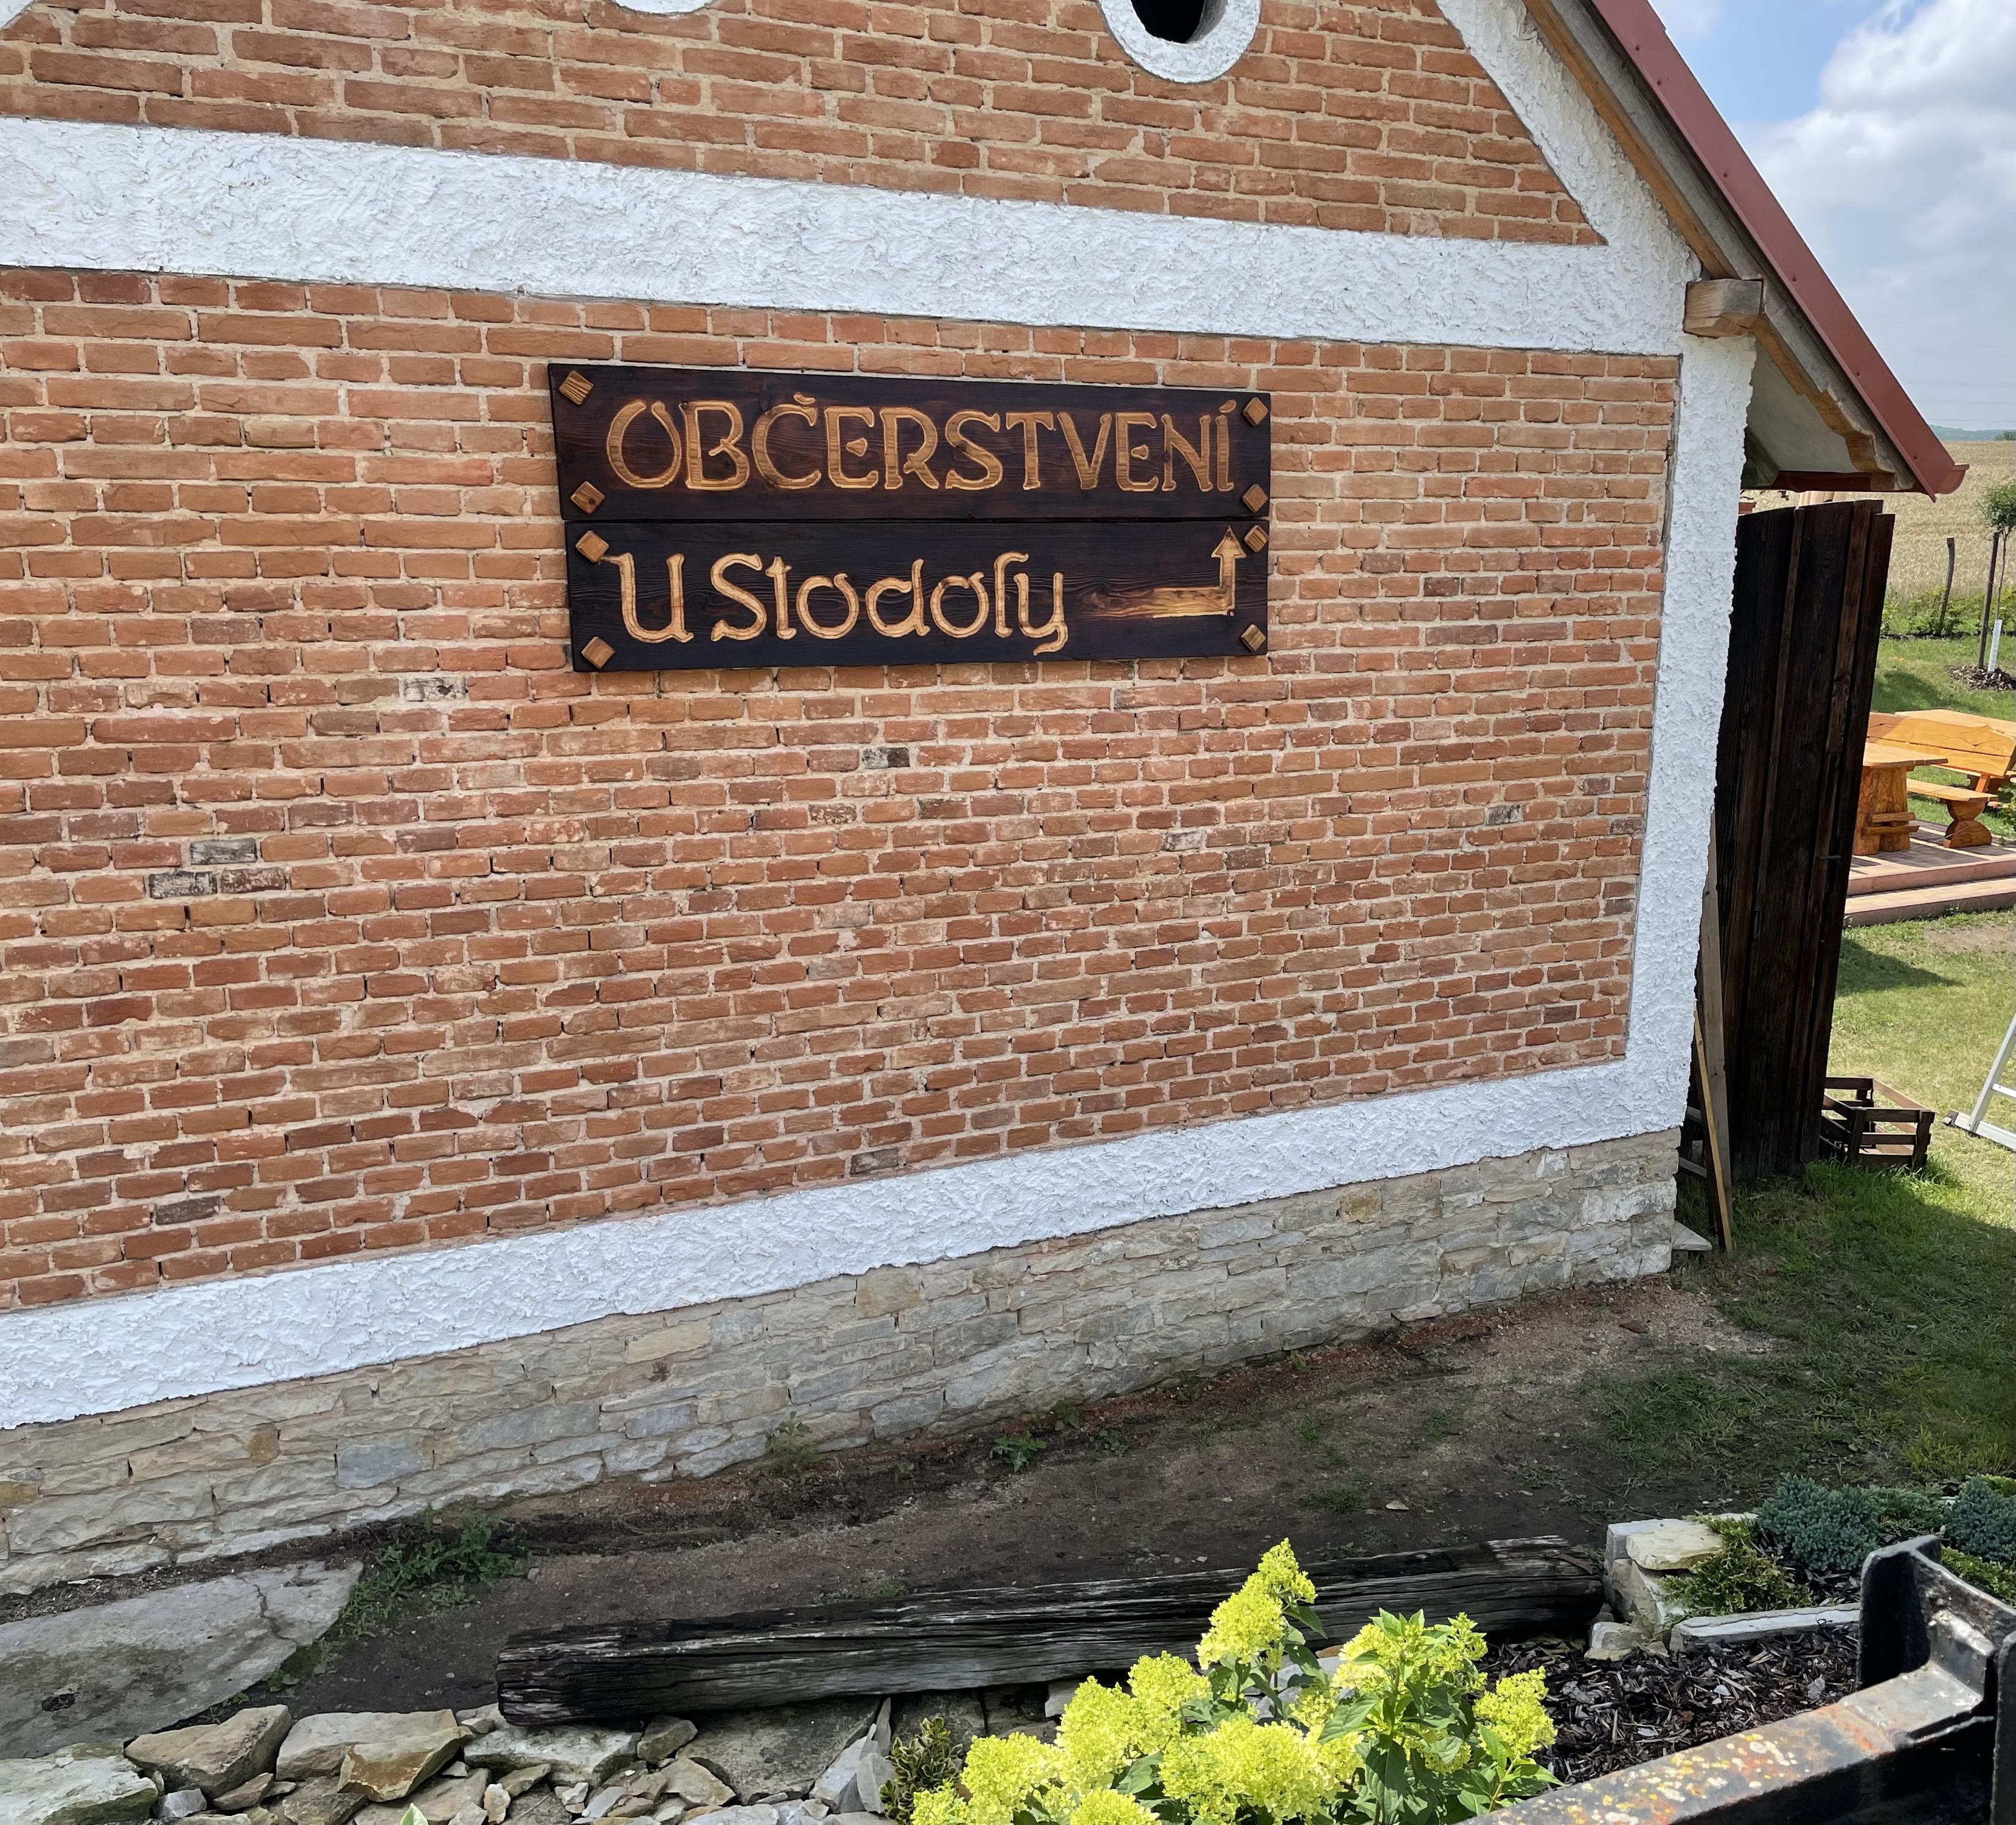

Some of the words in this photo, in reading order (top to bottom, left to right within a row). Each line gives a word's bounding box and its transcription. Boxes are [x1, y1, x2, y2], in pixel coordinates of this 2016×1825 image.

[606, 392, 1237, 493] OBČERSTVENÍ
[601, 552, 694, 644] U
[711, 551, 1065, 656] Stodoly
